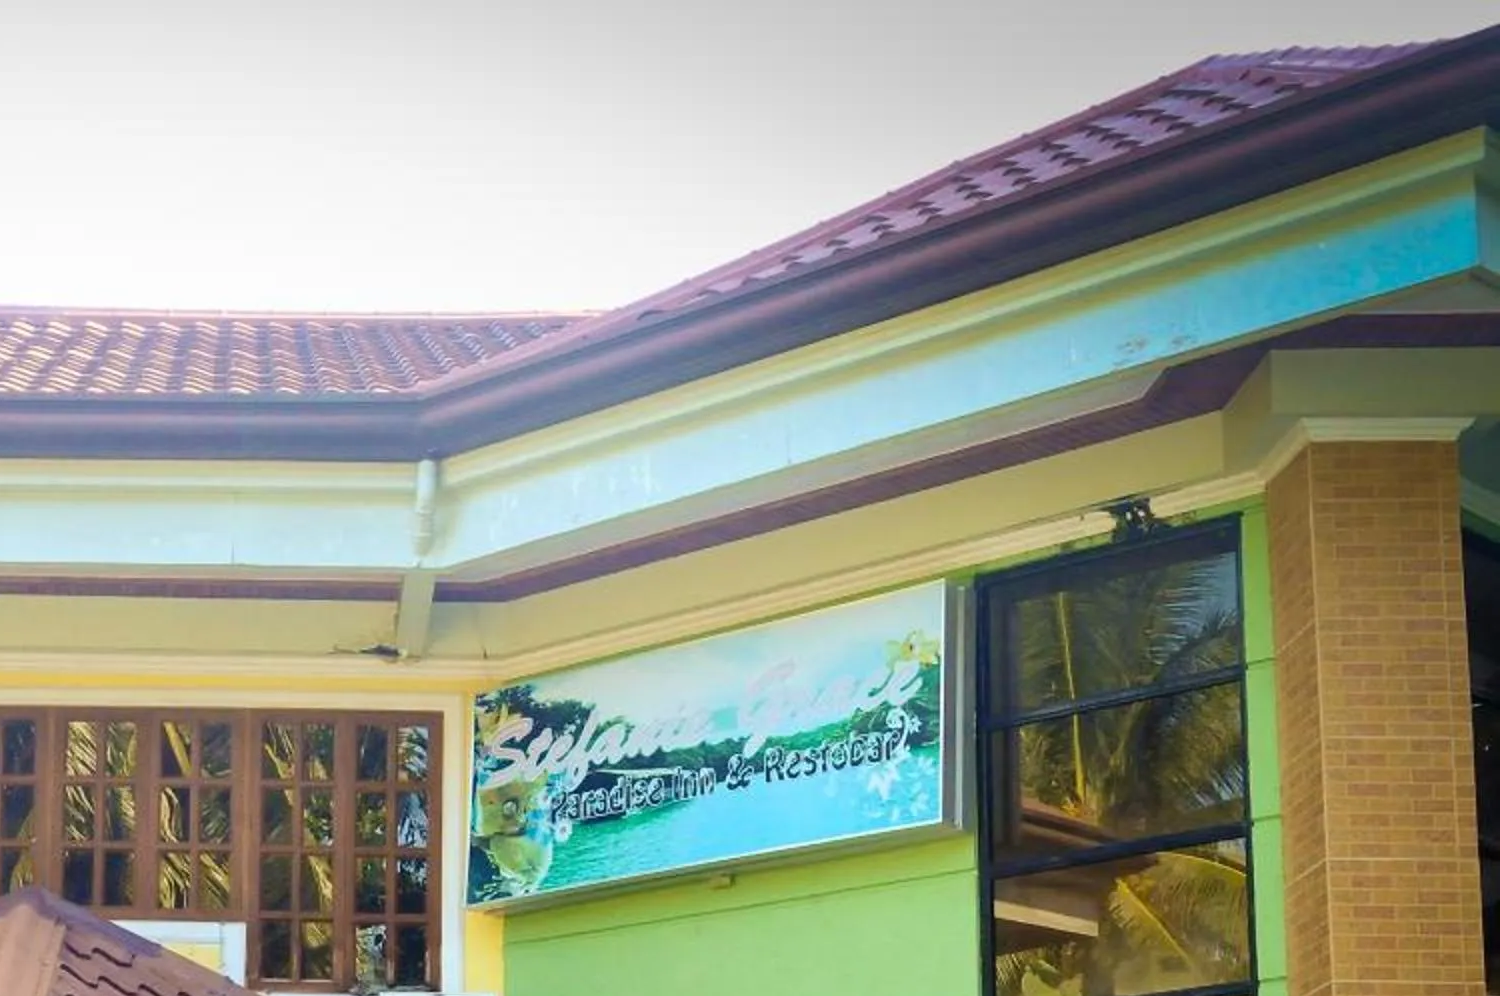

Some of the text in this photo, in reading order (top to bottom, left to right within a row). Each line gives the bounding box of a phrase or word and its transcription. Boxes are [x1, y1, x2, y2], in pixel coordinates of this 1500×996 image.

[551, 727, 904, 824] Paradise Inn & Restobar
